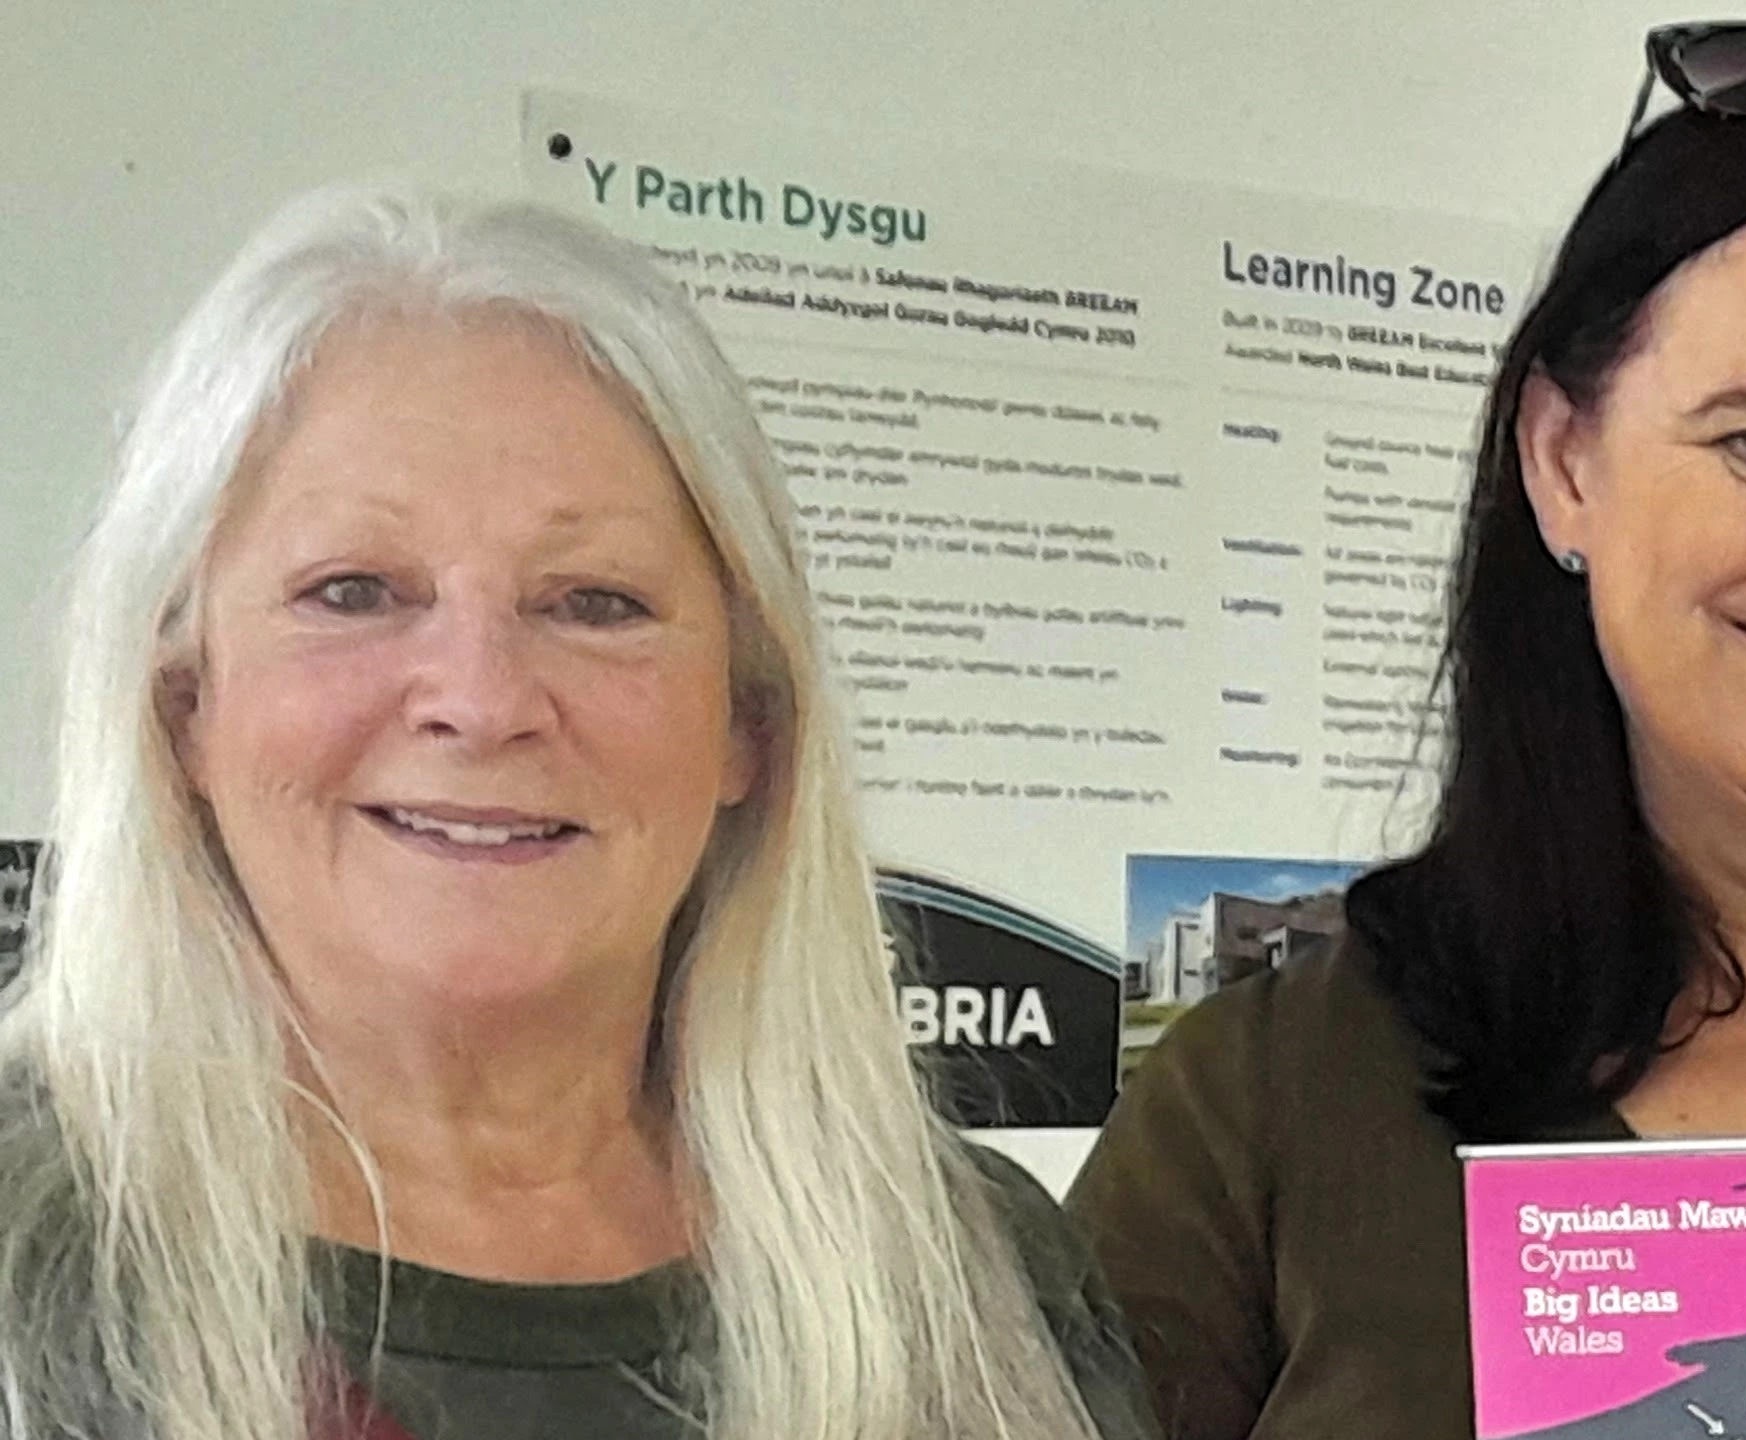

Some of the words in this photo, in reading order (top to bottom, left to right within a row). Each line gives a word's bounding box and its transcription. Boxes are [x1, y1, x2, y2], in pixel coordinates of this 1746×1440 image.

[585, 157, 616, 203] Y
[636, 165, 764, 224] Parth
[783, 184, 926, 246] Dysgu
[1223, 240, 1396, 308] Learning
[1410, 266, 1504, 314] Zone
[1519, 1204, 1669, 1240] Syniadau
[1521, 1244, 1636, 1279] Cymru
[1523, 1287, 1578, 1322] Big
[1587, 1284, 1678, 1315] Ideas
[1523, 1327, 1624, 1356] Wales
